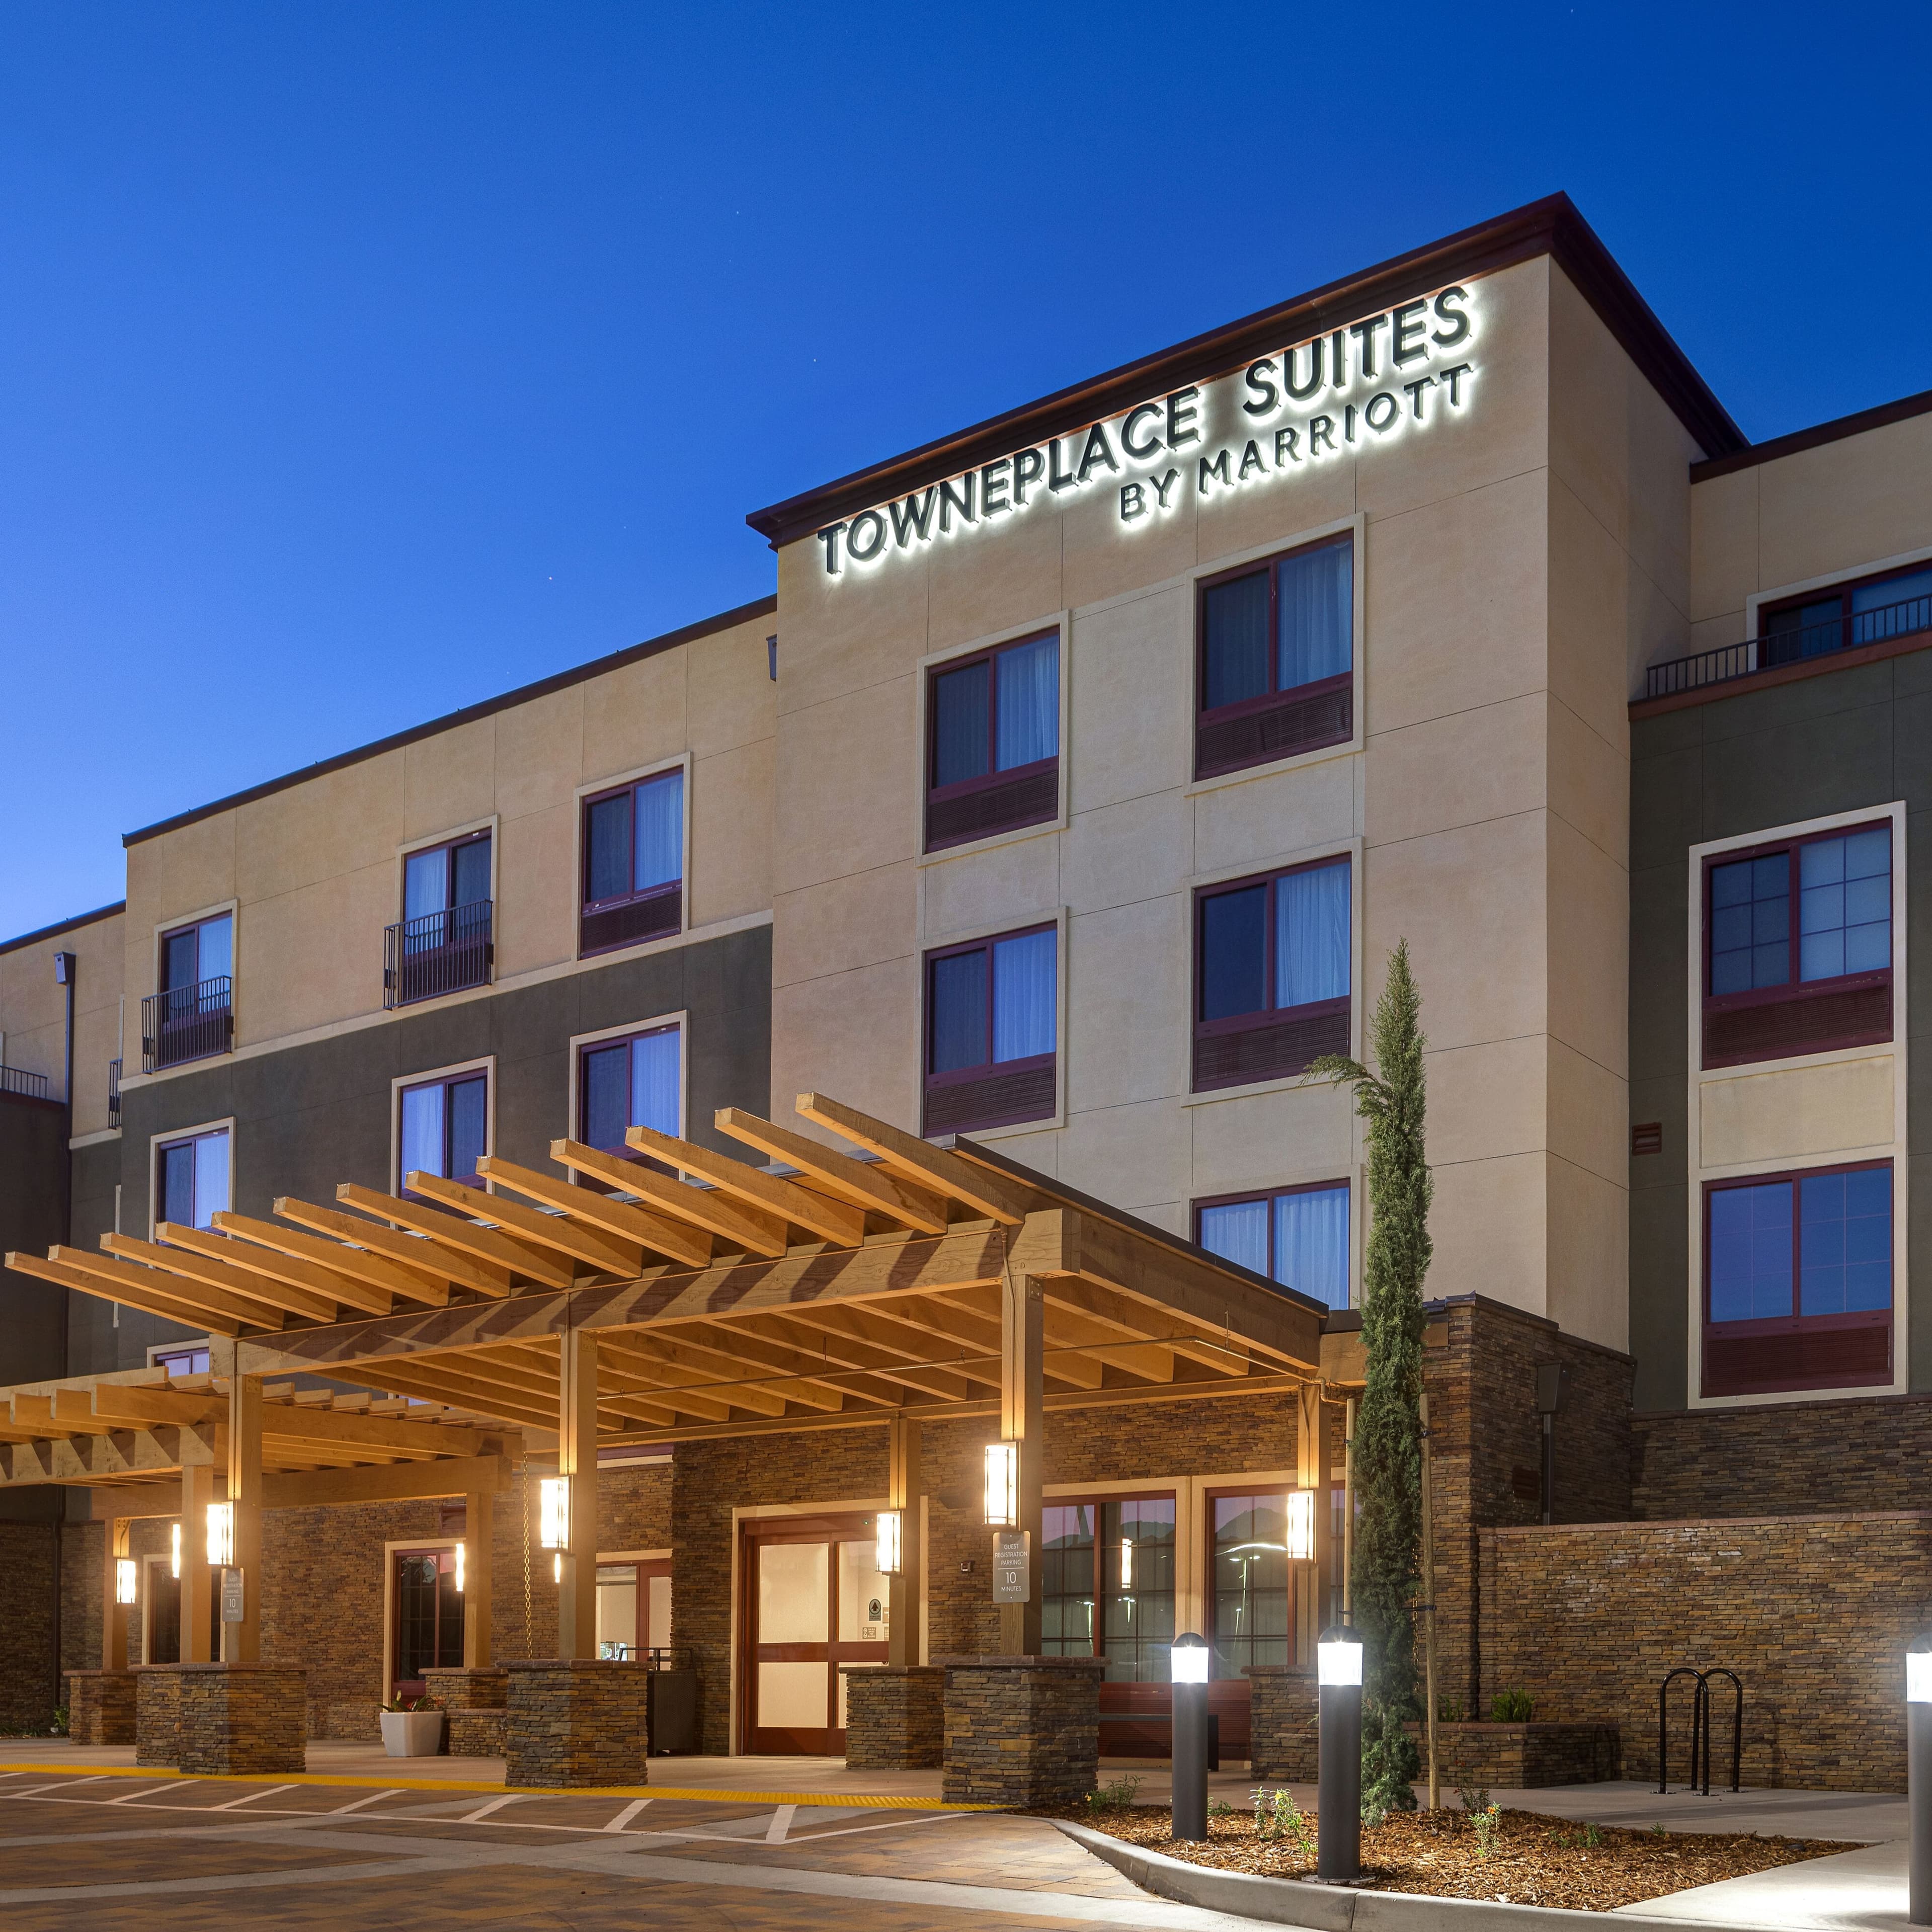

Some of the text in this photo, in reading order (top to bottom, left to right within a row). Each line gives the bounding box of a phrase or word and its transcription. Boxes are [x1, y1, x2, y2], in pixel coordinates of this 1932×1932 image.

[817, 286, 1471, 575] TOWNEPLACE SUITES
[1120, 363, 1473, 522] BY MARRIOTT
[229, 1598, 236, 1607] 10
[1006, 1572, 1016, 1583] 10
